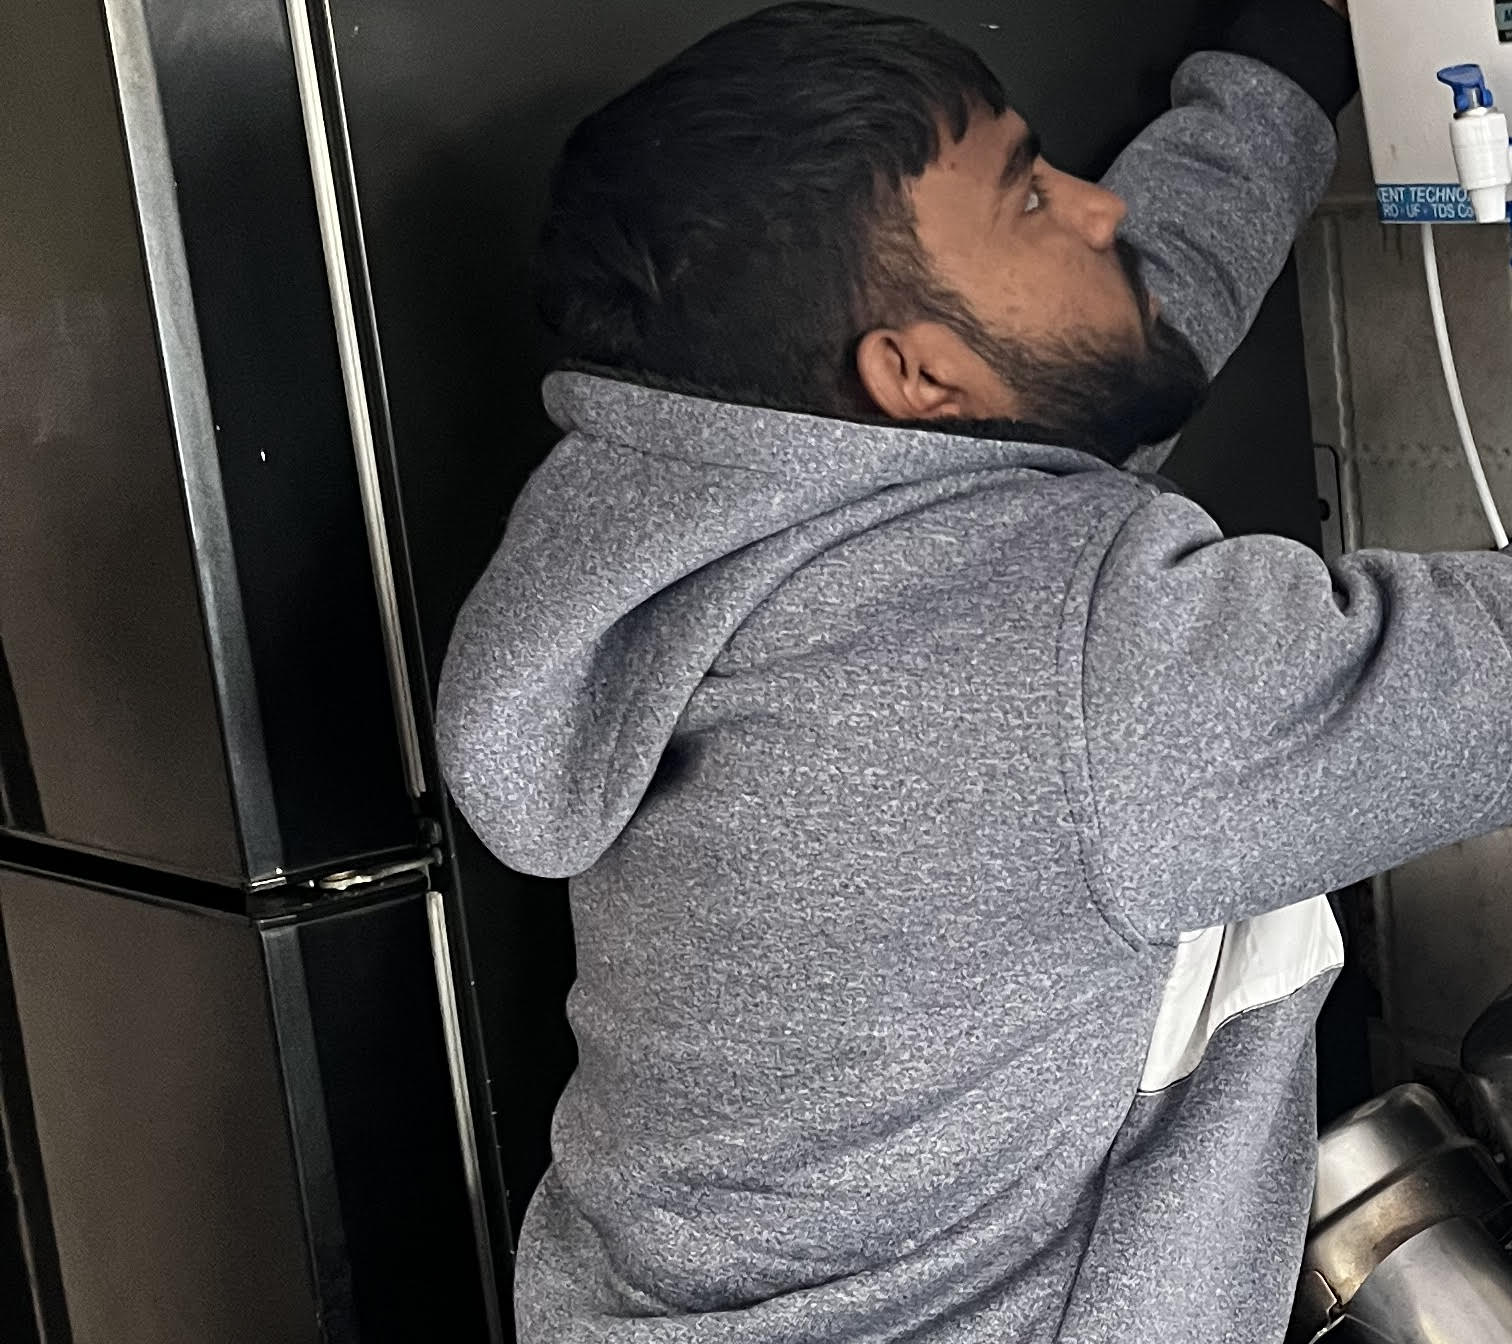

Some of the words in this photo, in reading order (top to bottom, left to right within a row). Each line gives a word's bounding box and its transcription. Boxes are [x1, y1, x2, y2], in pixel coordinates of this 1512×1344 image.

[1411, 187, 1471, 202] TECHNO
[1383, 203, 1399, 218] RO
[1406, 203, 1421, 218] UF
[1431, 203, 1454, 218] TDS
